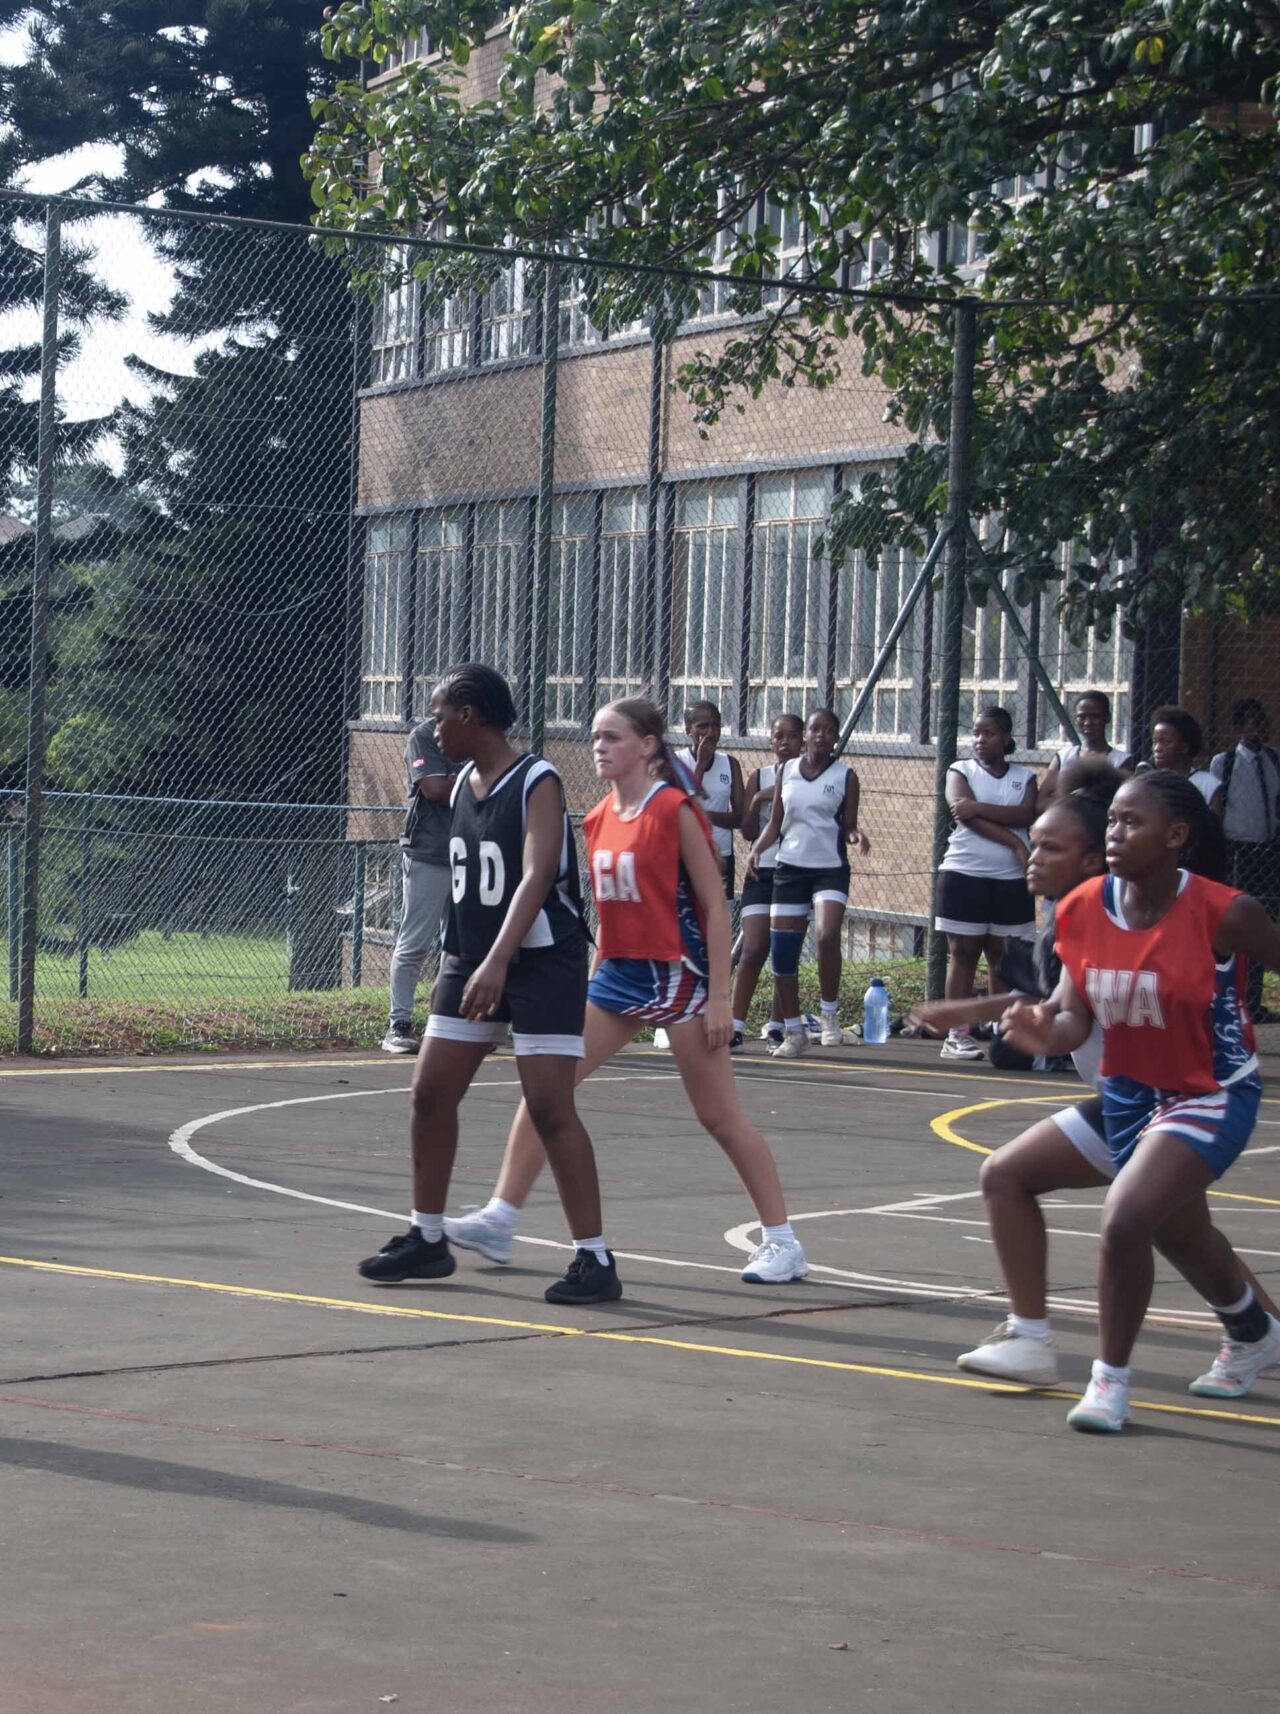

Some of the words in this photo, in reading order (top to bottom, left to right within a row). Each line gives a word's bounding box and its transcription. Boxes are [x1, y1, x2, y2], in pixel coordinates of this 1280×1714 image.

[449, 836, 505, 906] GD
[593, 849, 642, 903] GA
[1085, 968, 1166, 1029] WA
